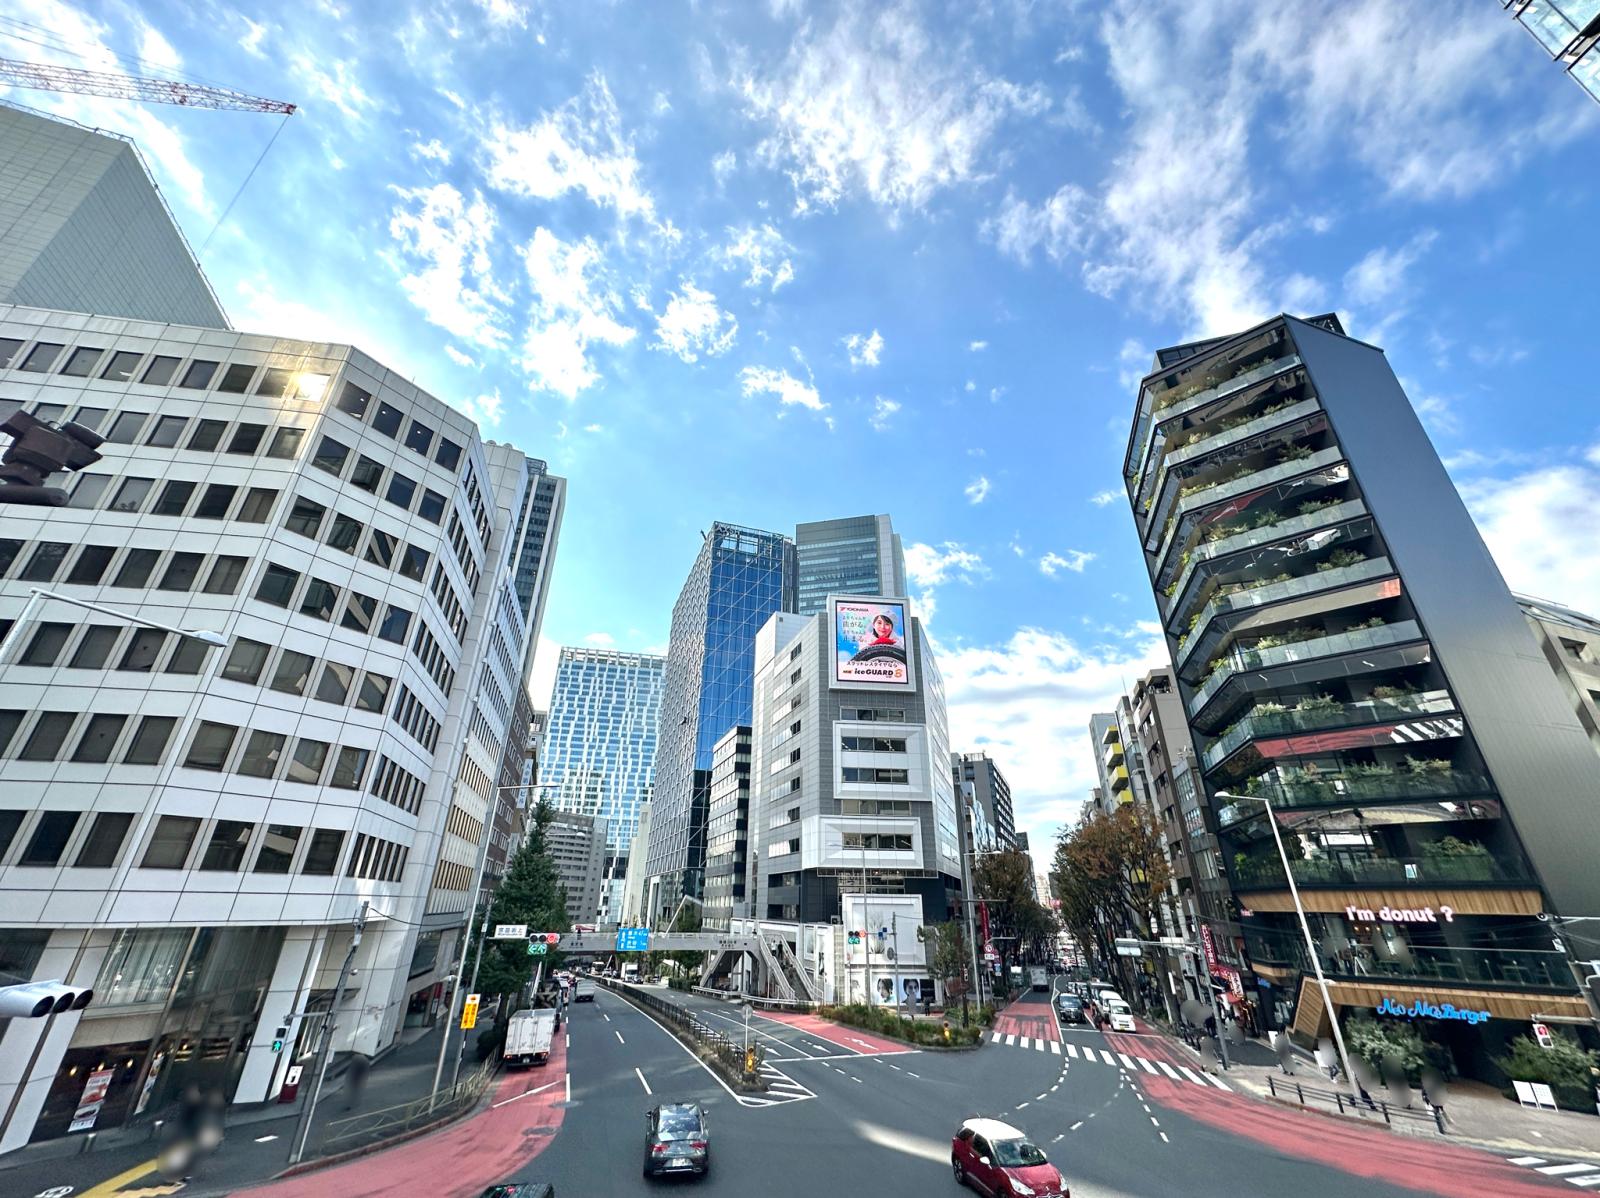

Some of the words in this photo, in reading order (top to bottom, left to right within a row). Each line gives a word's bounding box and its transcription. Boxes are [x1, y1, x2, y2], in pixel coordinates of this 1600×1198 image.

[854, 668, 894, 676] iceGUARD
[1346, 906, 1375, 921] I'm
[1379, 906, 1437, 922] donut
[1440, 905, 1455, 923] ?
